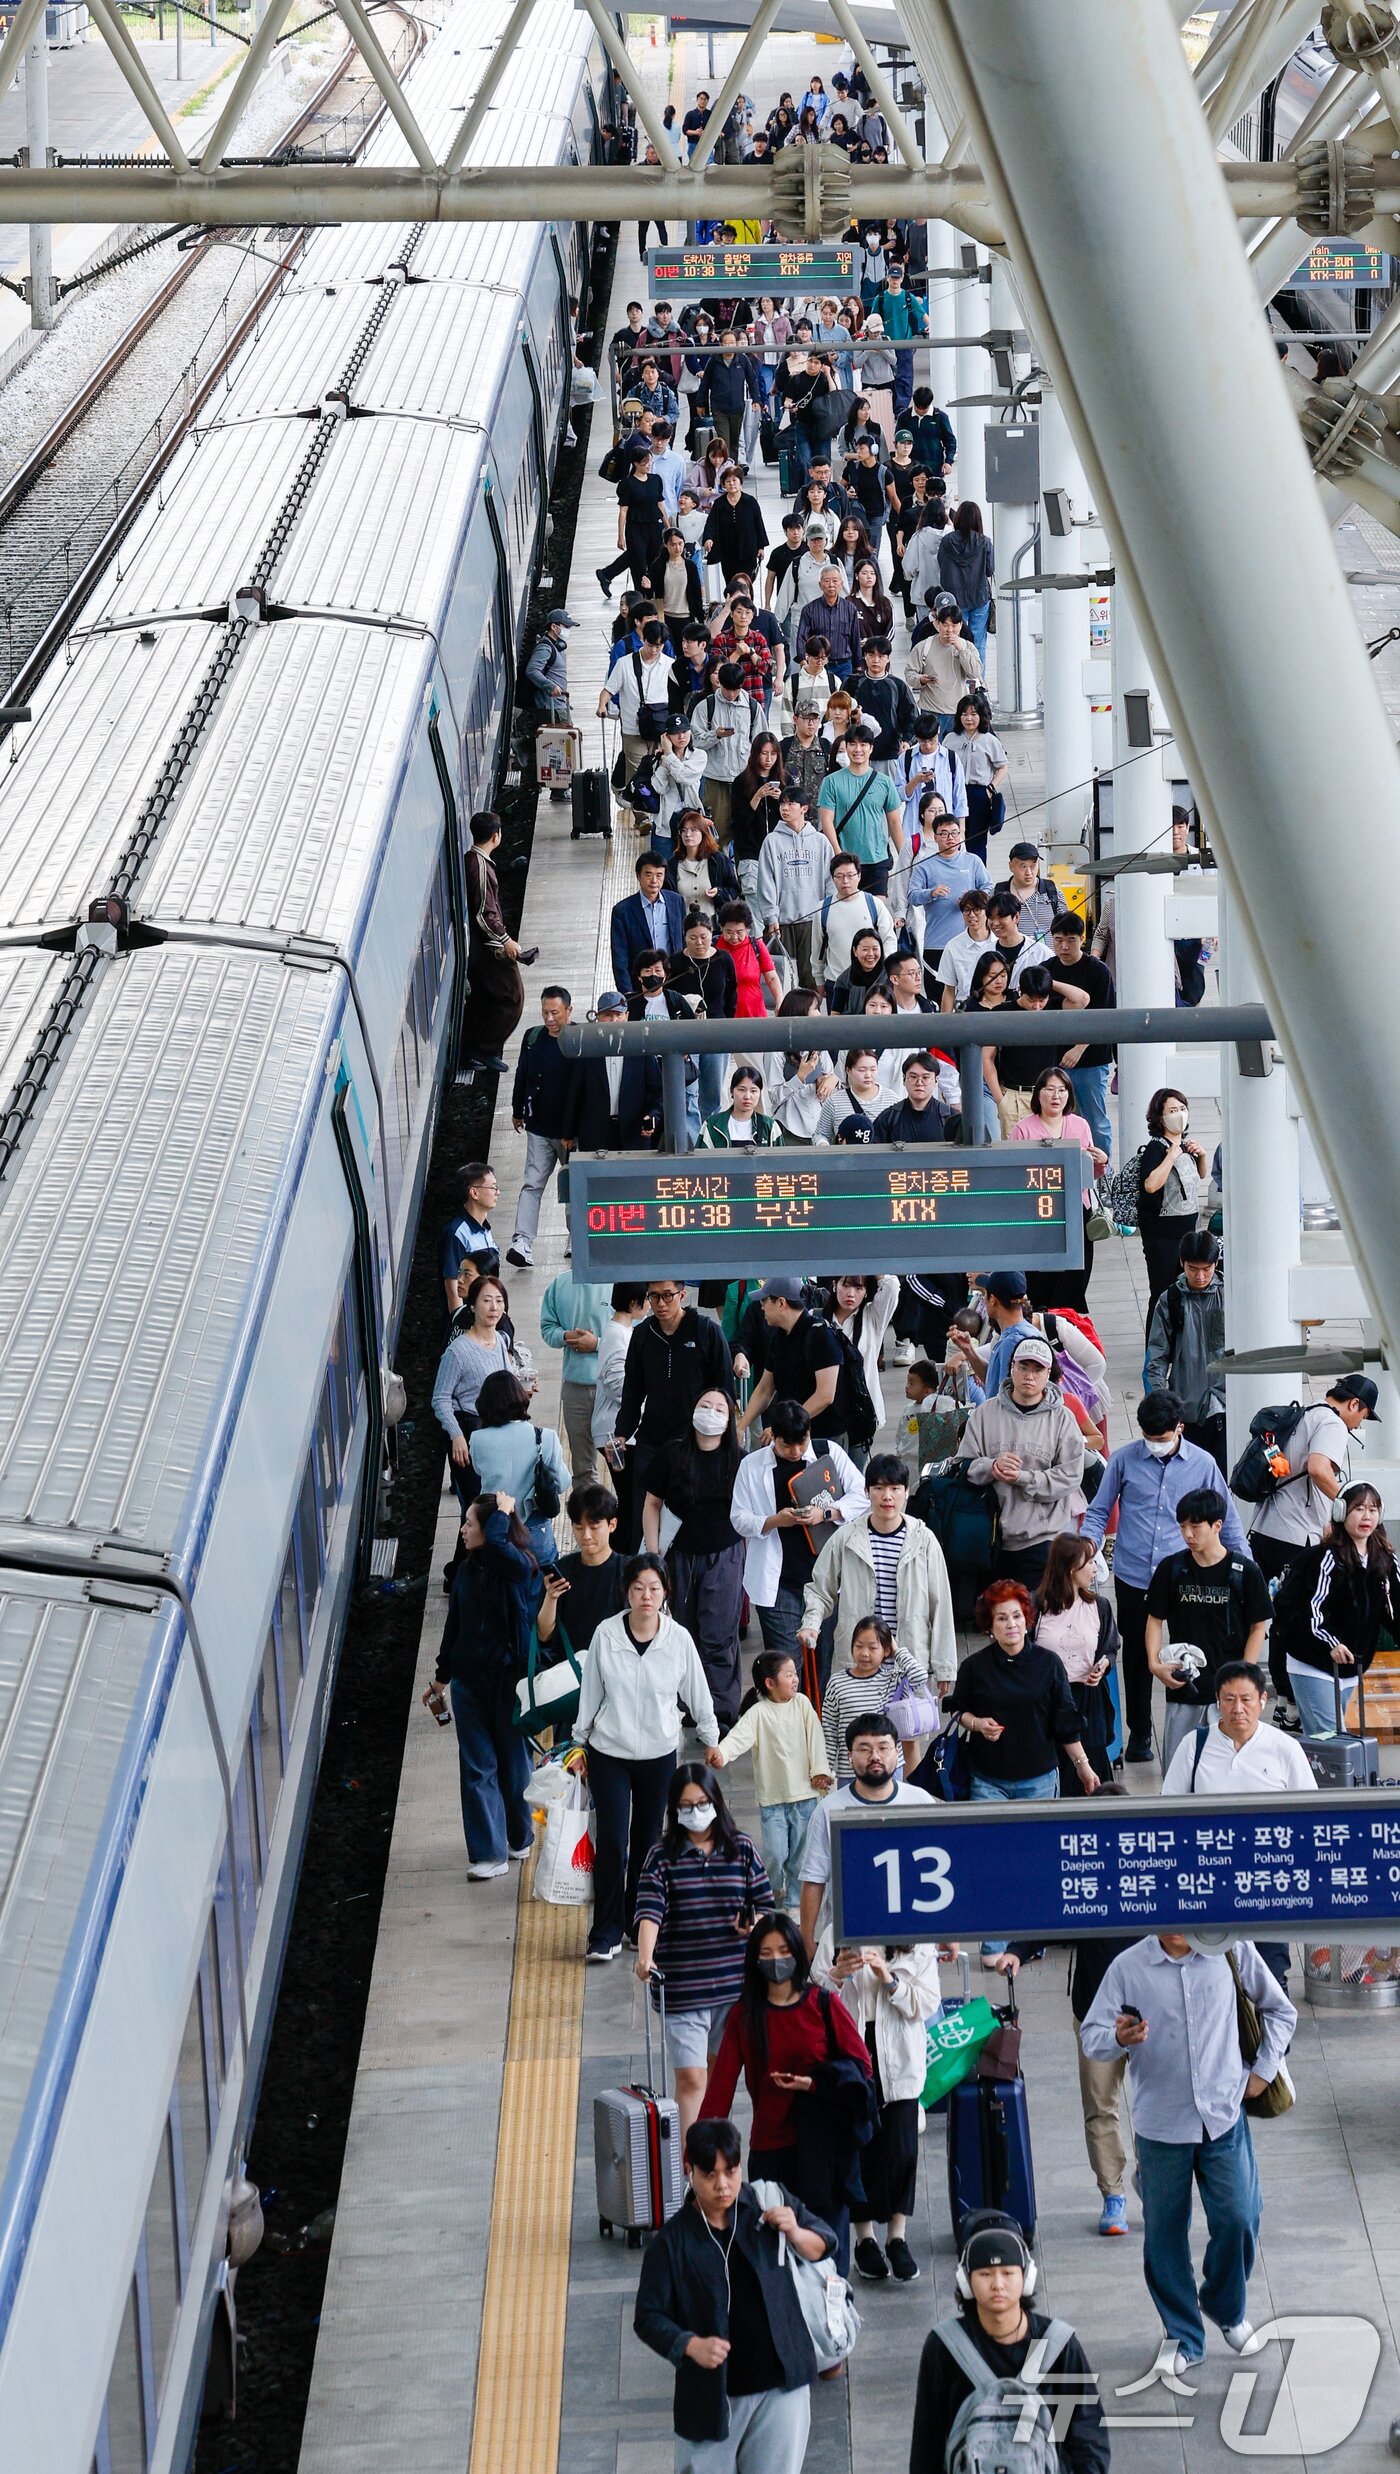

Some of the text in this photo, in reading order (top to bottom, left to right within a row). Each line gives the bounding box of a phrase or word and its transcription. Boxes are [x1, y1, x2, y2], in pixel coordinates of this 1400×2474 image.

[836, 252, 852, 263] 지연
[655, 264, 849, 278] 이번 10:38 부산 KTX 8
[675, 717, 682, 726] S
[783, 867, 813, 878] STUDIO
[655, 1167, 1062, 1200] 도착시간 출발역 열차종류 지연
[588, 1195, 1054, 1232] 이번 10:38 부산 KTX 8
[1060, 1833, 1098, 1856] 대전
[1118, 1831, 1176, 1855] 동대구
[1195, 1828, 1236, 1851] 부산
[1254, 1826, 1294, 1849] 포항
[1312, 1824, 1350, 1847] 진주
[1061, 1859, 1105, 1873] Daejeon
[1118, 1857, 1177, 1872] Dongdaegu
[1198, 1854, 1232, 1867] Busan
[1254, 1852, 1294, 1866] Pohang
[1315, 1850, 1341, 1863] Jinju
[873, 1846, 955, 1914] 13
[1061, 1876, 1099, 1900] 안동
[1118, 1874, 1157, 1898] 원주
[1176, 1872, 1216, 1895] 익산
[1234, 1868, 1310, 1893] 광주송정
[1330, 1866, 1368, 1889] 목포
[1062, 1892, 1369, 1917] Andong Wonju Iksan Gwangju songjeong Mokpo
